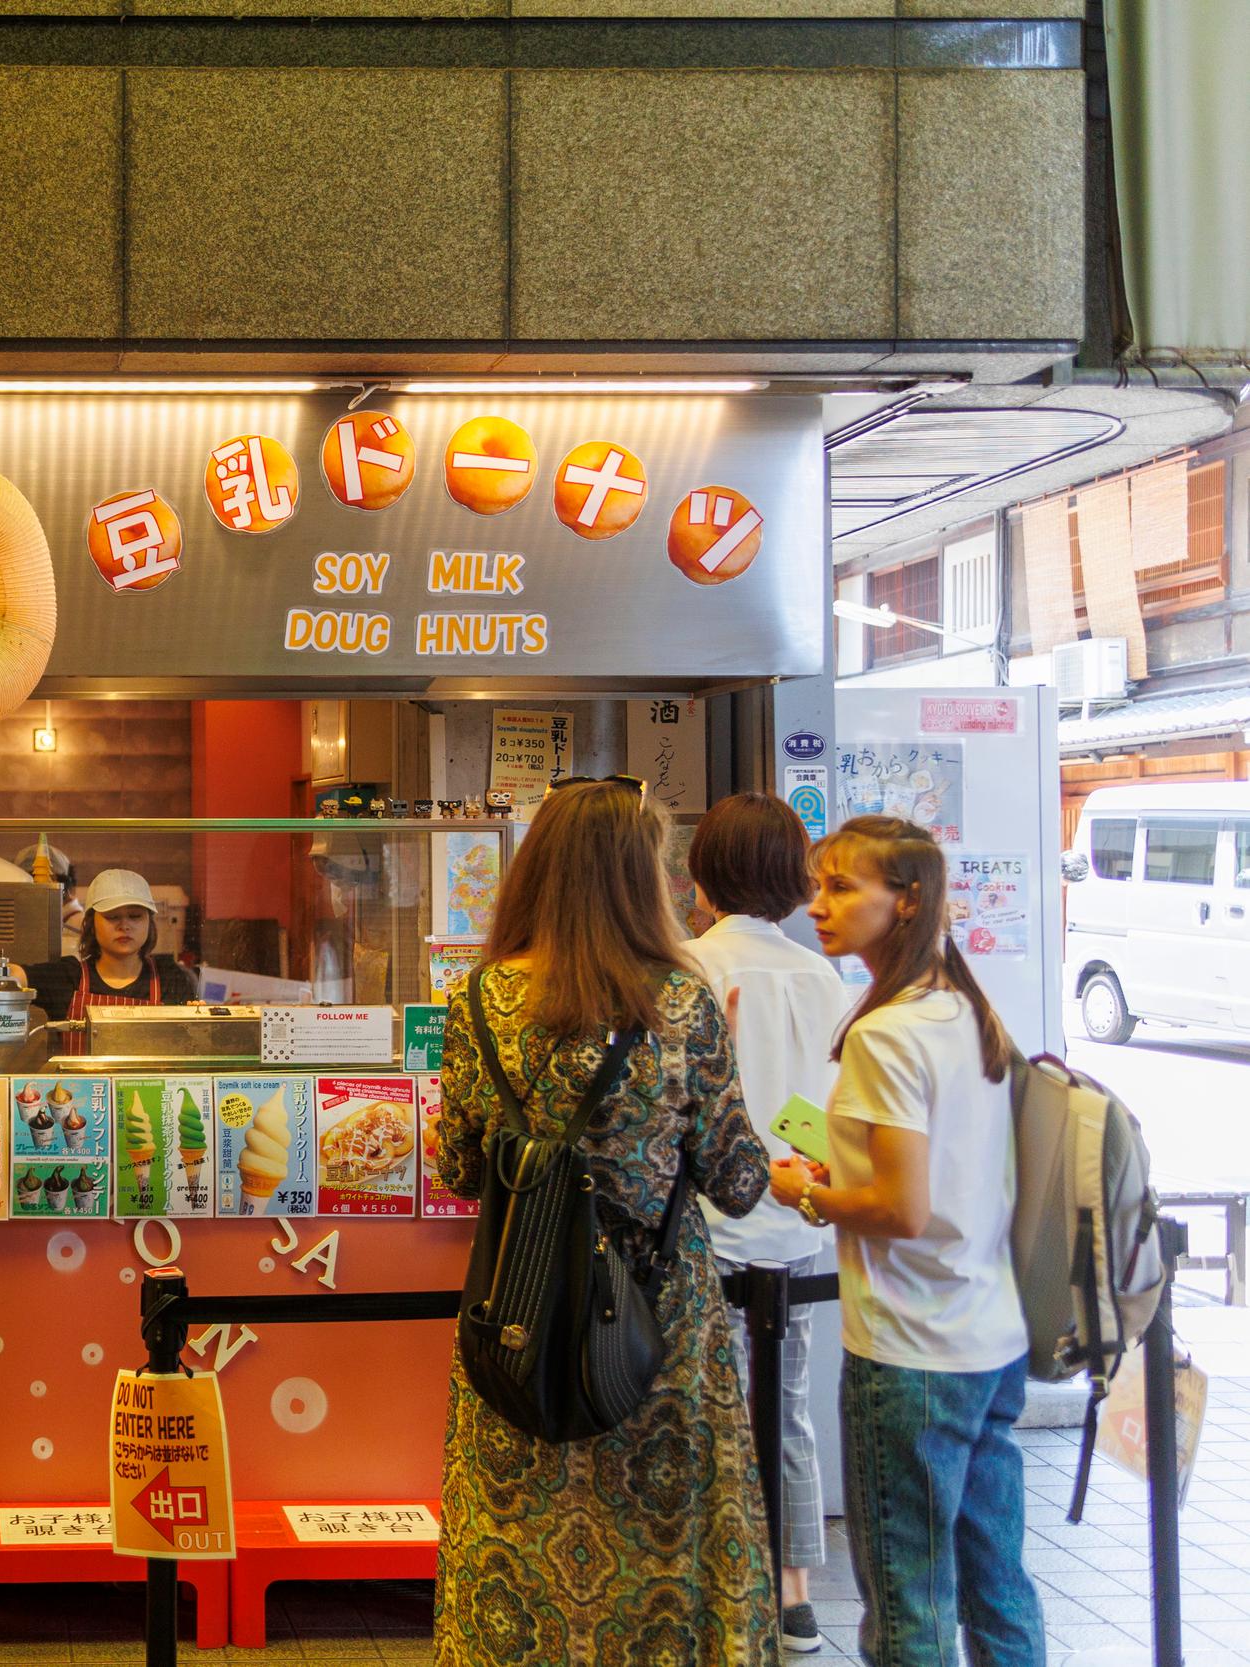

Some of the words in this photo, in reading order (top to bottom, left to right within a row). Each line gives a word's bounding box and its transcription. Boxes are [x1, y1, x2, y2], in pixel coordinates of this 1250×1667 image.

[92, 416, 763, 592] 豆乳ドーナツ
[316, 553, 388, 592] SOY
[433, 554, 523, 592] MILK
[287, 613, 389, 651] DOUG
[420, 614, 546, 653] HNUTS
[649, 700, 680, 724] 酒
[960, 719, 986, 730] vending
[987, 720, 1014, 730] machine
[787, 739, 822, 748] 消費税
[836, 747, 902, 778] 乳おから
[908, 749, 959, 767] クッキー
[959, 861, 1022, 875] TREATS
[976, 881, 1017, 892] Cookies
[316, 1013, 355, 1021] FOLLOW
[355, 1013, 369, 1021] ME
[218, 1081, 240, 1090] Soymilk
[240, 1081, 252, 1089] soft
[253, 1081, 262, 1089] ice
[292, 1080, 309, 1183] 豆乳ソフトクリーム
[91, 1082, 107, 1215] 豆乳ソフトサンデー
[326, 1163, 407, 1183] 豆乳ドーナツ
[130, 1193, 154, 1204] ¥400
[184, 1193, 209, 1204] ¥400
[277, 1190, 313, 1205] ¥350
[287, 1204, 311, 1214] (税込)
[332, 1204, 351, 1214] 6個
[361, 1204, 397, 1214] ¥550
[438, 1204, 456, 1215] 6個
[116, 1382, 130, 1406] DO
[132, 1385, 156, 1410] NOT
[115, 1412, 153, 1439] ENTER
[157, 1415, 195, 1440] HERE
[115, 1441, 209, 1464] こちらからは並ばないで
[115, 1462, 147, 1480] ください
[149, 1490, 203, 1521] 出口
[9, 1513, 111, 1526] お子様
[297, 1511, 425, 1523] お子様用
[316, 1522, 413, 1535] 覗き台
[178, 1531, 226, 1550] OUT
